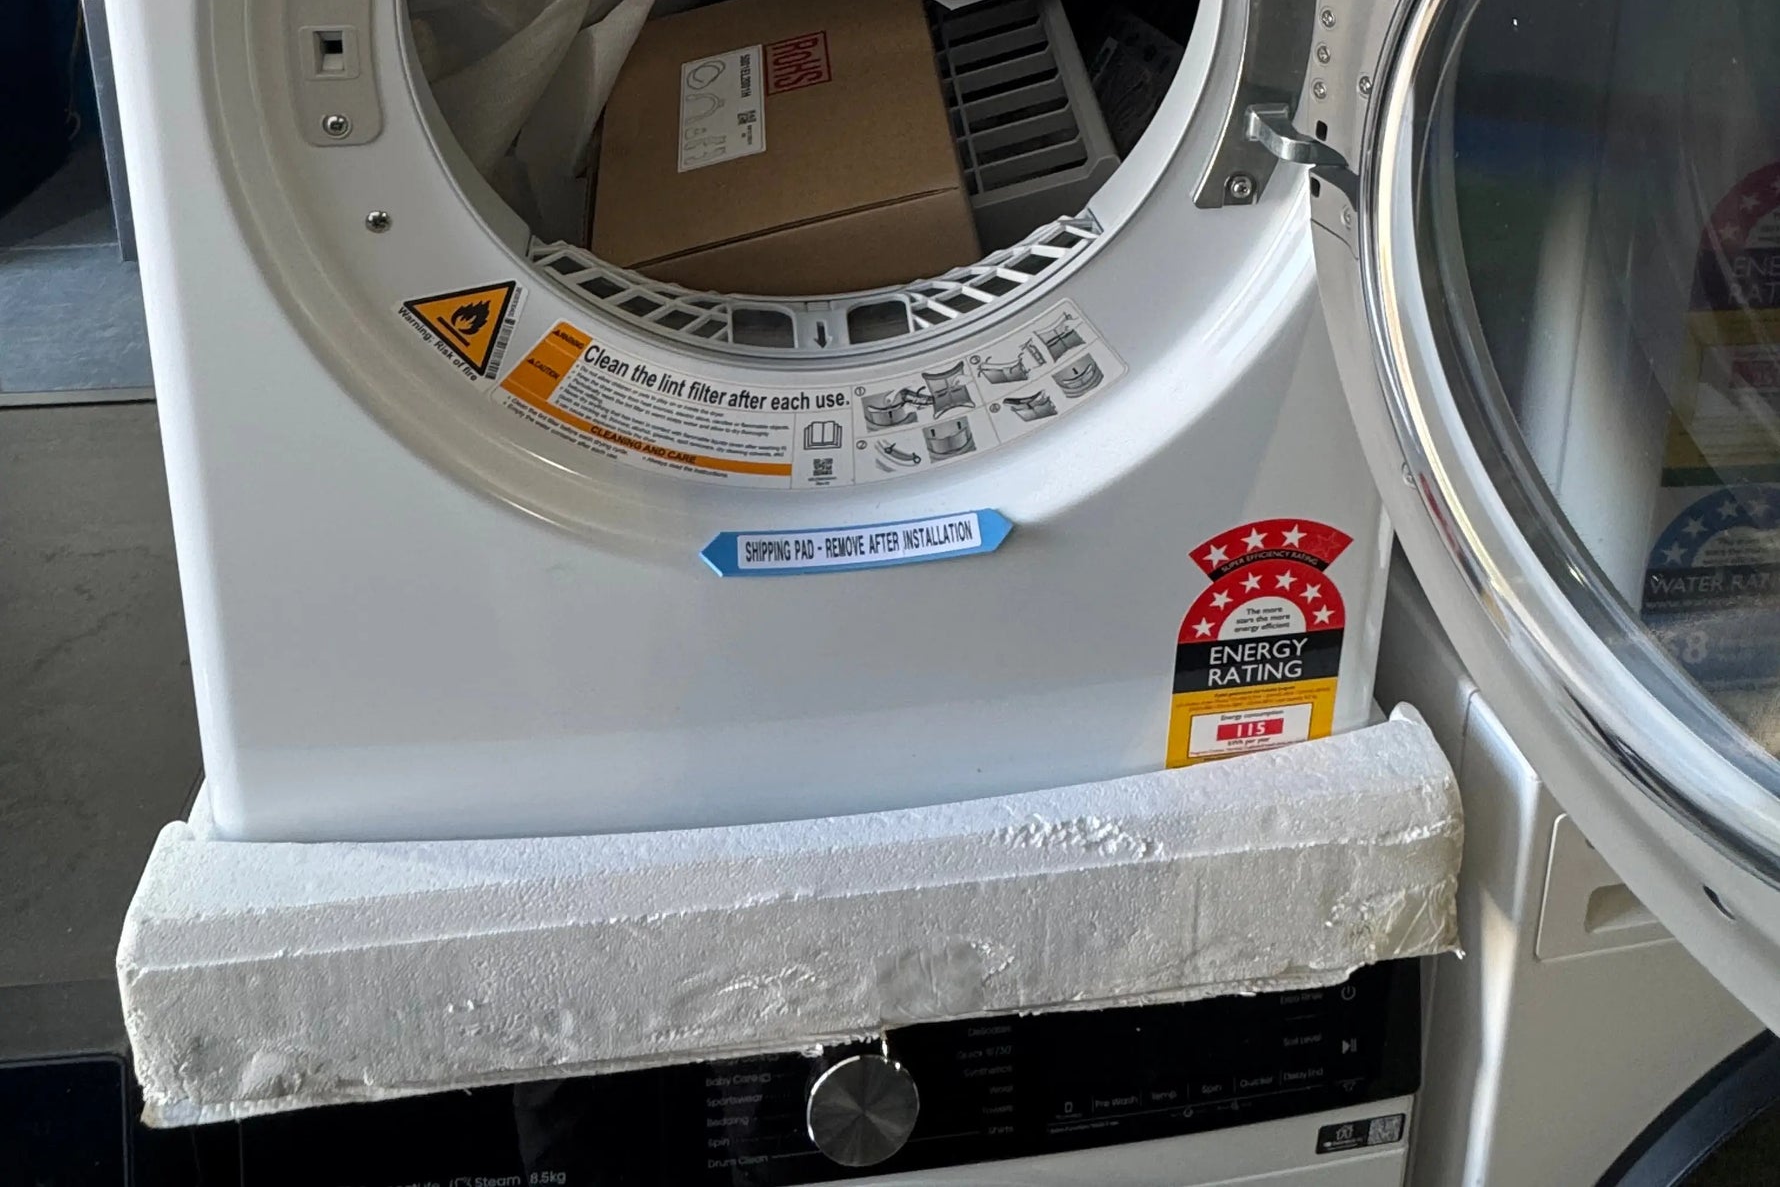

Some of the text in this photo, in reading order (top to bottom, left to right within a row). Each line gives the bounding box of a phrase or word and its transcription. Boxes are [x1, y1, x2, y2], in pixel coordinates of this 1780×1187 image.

[772, 38, 823, 89] RoHS
[399, 307, 477, 381] Warning: Risk of fire
[584, 344, 629, 378] Clean
[631, 364, 657, 388] the
[658, 374, 686, 398] lint
[688, 382, 727, 406] filter
[728, 391, 767, 410] after
[770, 392, 810, 410] each
[815, 392, 850, 408] use.
[590, 425, 642, 452] CLEANING
[642, 443, 666, 458] AND
[667, 449, 697, 465] CARE
[745, 539, 791, 563] SHIPPING
[794, 538, 814, 561] PAD
[826, 534, 865, 558] REMOVE
[869, 532, 899, 553] AFTER
[903, 520, 973, 550] INSTALLATION
[1221, 550, 1318, 572] SUPER EFFICIENCY RATING
[1650, 576, 1722, 594] WATER
[1247, 607, 1262, 615] The
[1257, 615, 1269, 623] the
[1234, 625, 1260, 634] energy
[1209, 638, 1308, 665] ENERGY
[1207, 660, 1303, 686] RATING
[1220, 709, 1284, 721] Energy consumption
[1236, 721, 1266, 737] 115
[1244, 738, 1256, 746] per
[1258, 736, 1271, 744] year
[707, 1094, 763, 1107] Sportswear
[708, 1138, 730, 1148] Spin
[475, 1172, 567, 1187] Steam 8.5kg
